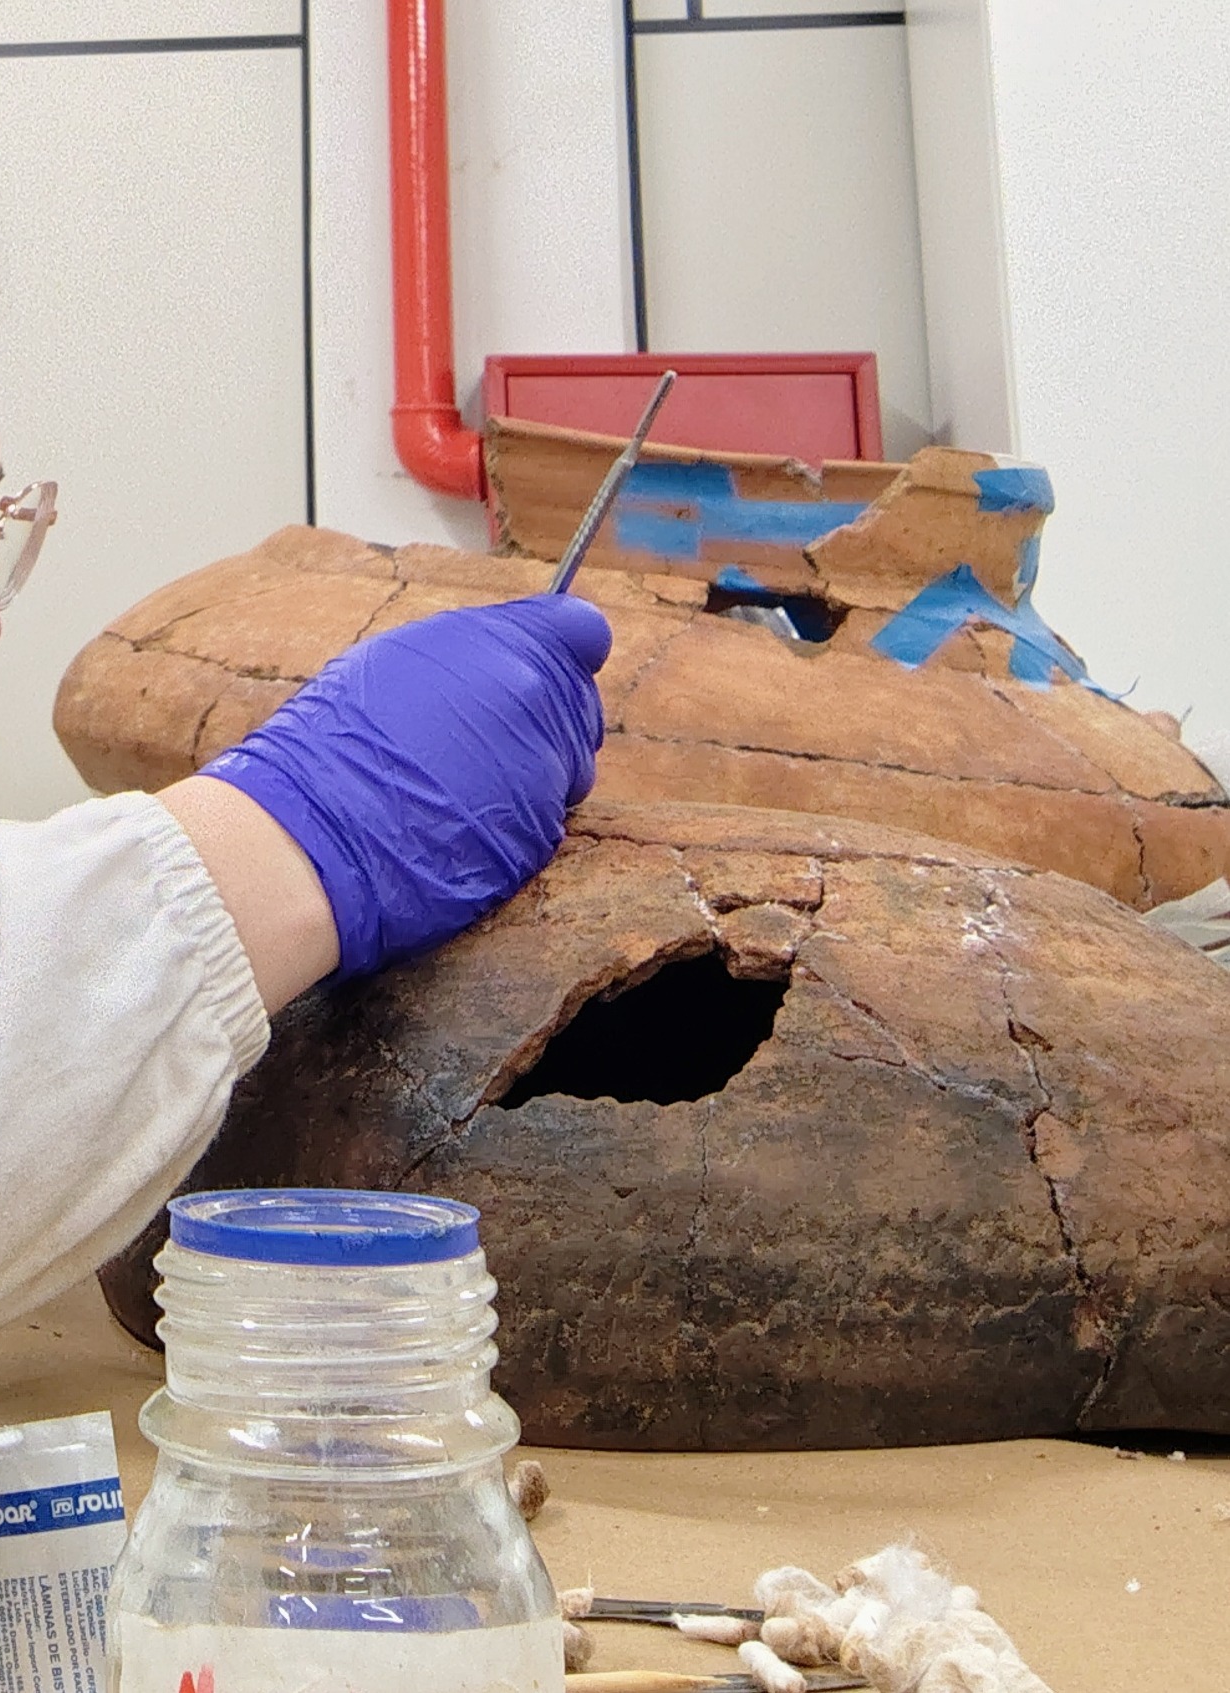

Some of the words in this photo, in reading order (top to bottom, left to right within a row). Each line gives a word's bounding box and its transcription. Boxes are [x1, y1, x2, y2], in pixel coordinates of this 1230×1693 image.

[38, 1574, 58, 1640] LÂMINAS
[58, 1572, 75, 1645] ESTERILIZADO
[68, 1647, 79, 1671] POR
[47, 1642, 60, 1664] DE
